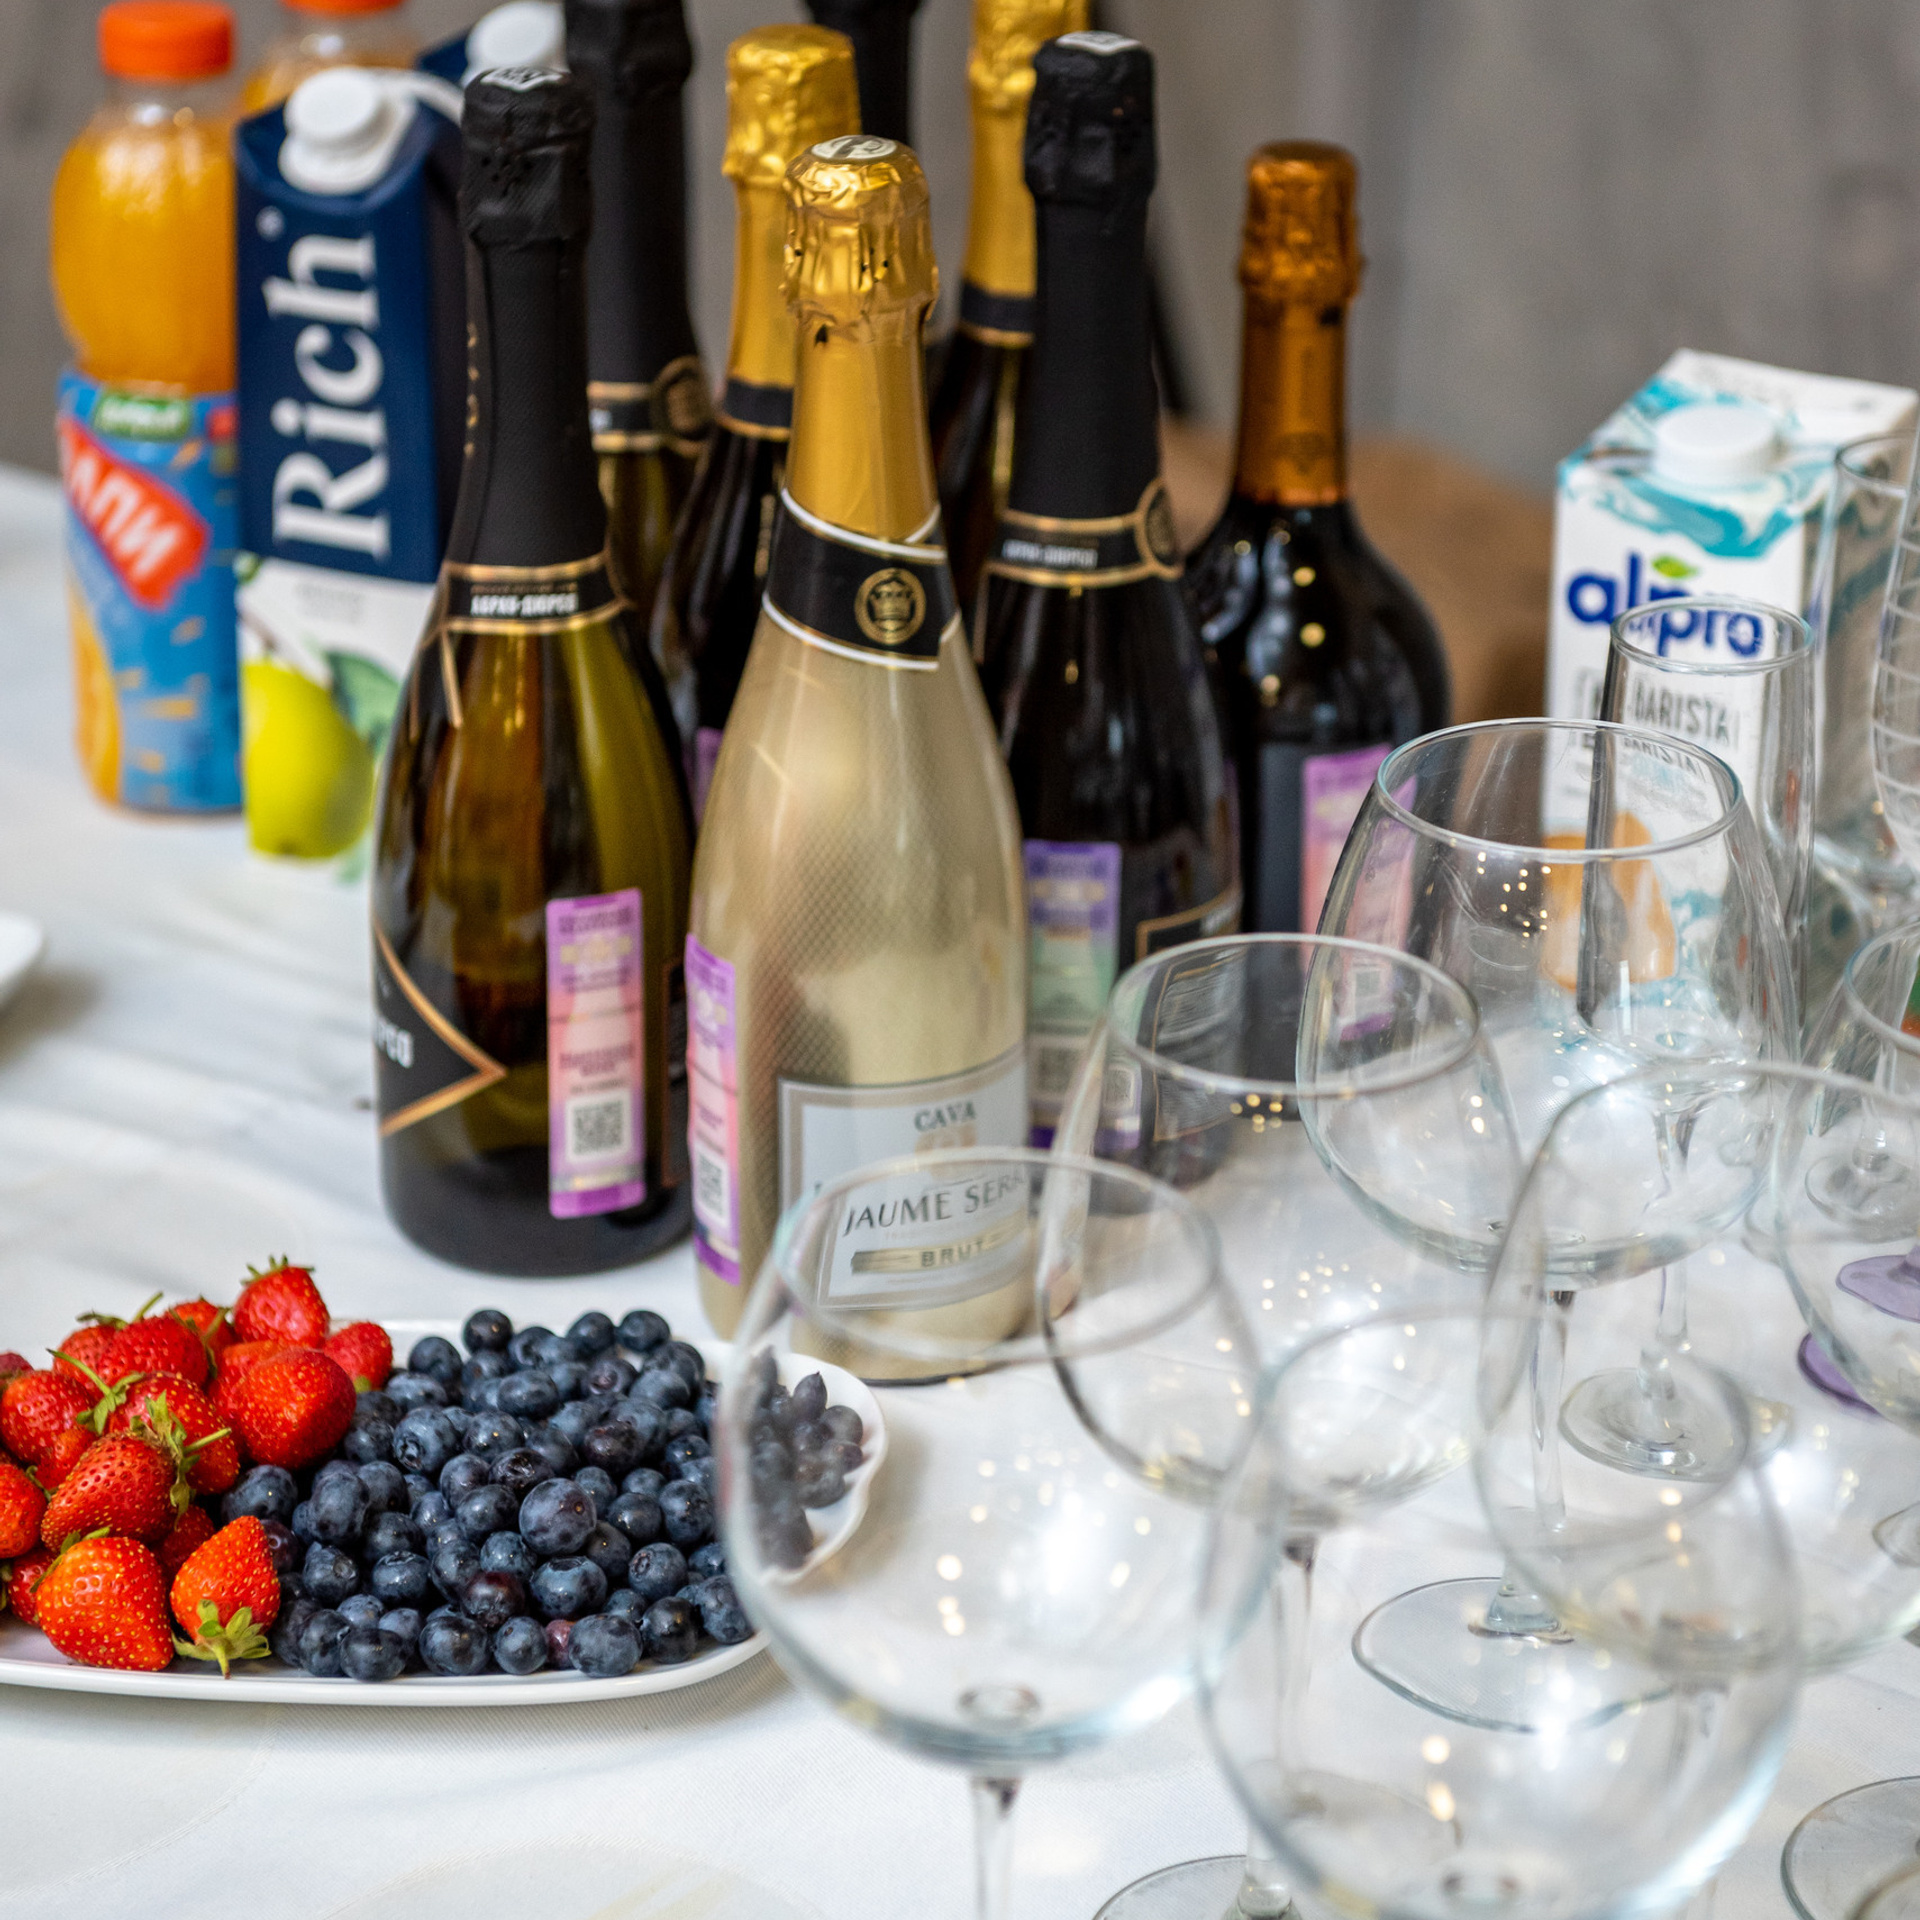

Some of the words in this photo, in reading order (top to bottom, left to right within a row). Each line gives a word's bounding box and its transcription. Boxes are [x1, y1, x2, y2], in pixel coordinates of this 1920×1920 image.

[261, 232, 392, 564] Rich
[1567, 549, 1764, 658] alpro
[914, 1100, 977, 1132] CAVA
[843, 1191, 953, 1237] JAUME
[919, 1240, 984, 1268] BRUT
